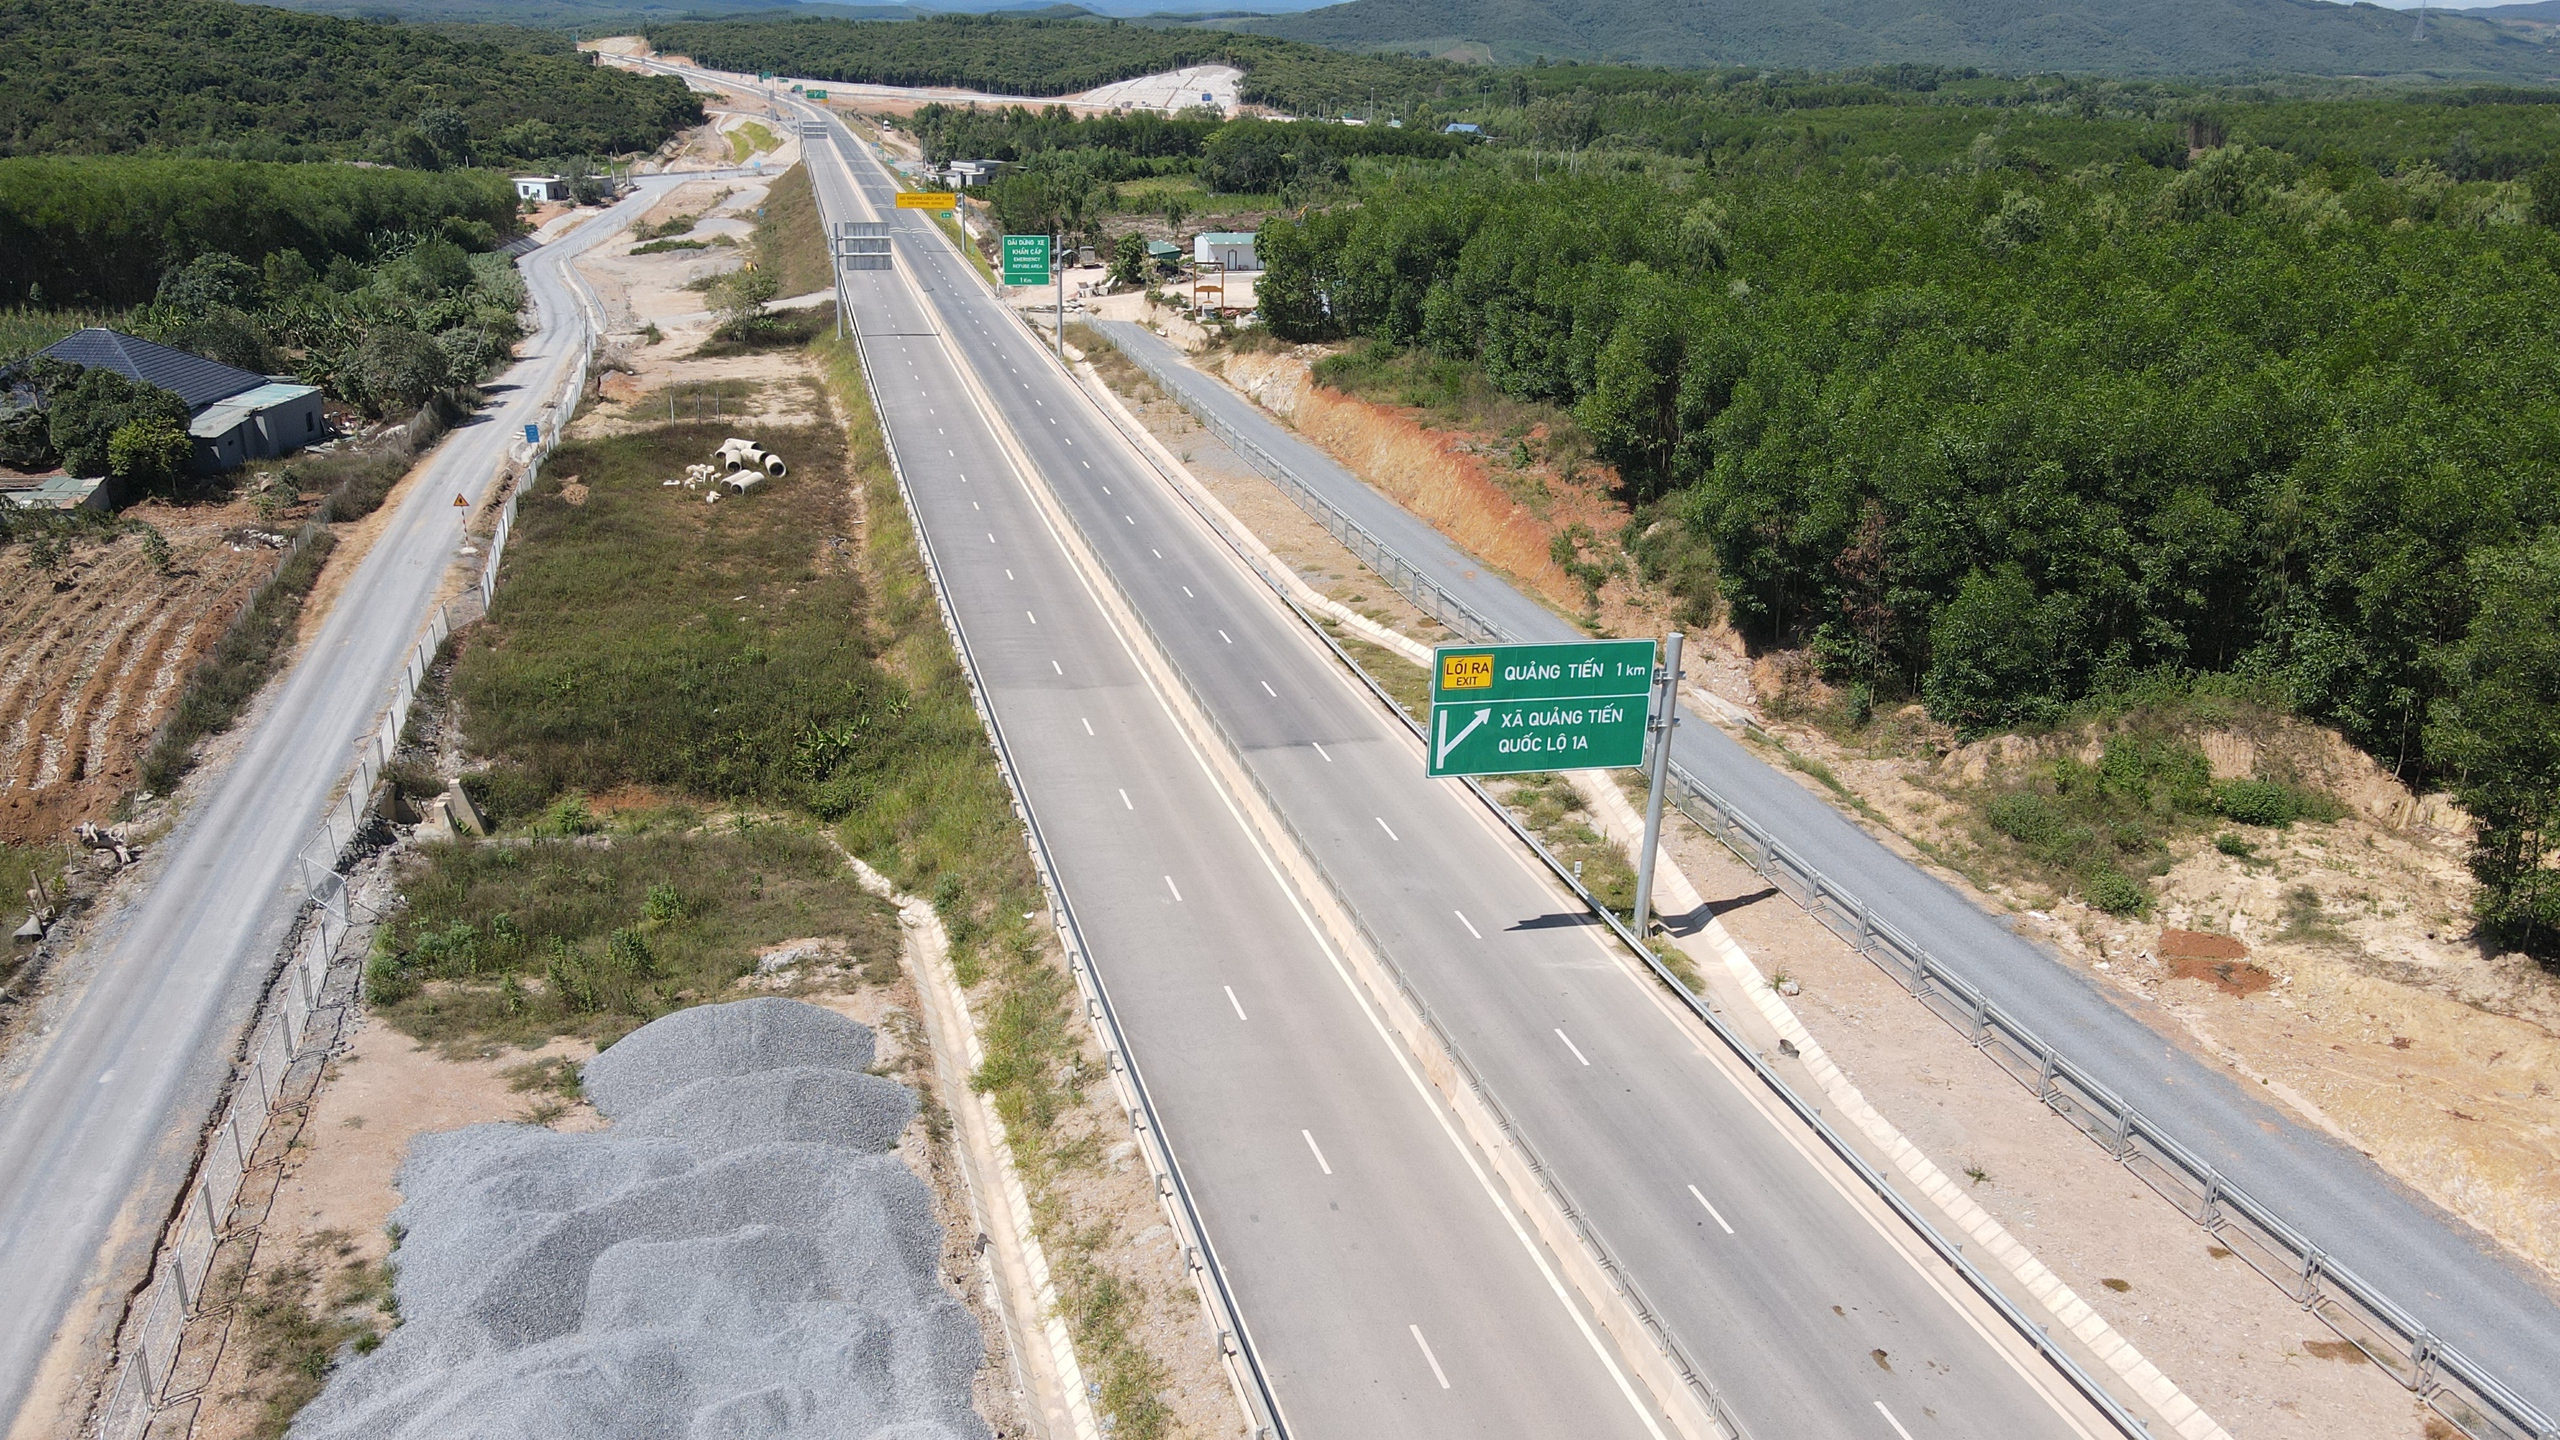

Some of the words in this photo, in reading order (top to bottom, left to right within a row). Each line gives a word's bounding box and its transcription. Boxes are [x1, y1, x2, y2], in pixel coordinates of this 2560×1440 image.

[1446, 658, 1467, 675] LỐI
[1471, 662, 1490, 674] RA
[1504, 660, 1561, 681] QUẢNG
[1568, 657, 1604, 679] TIẾN
[1616, 662, 1622, 677] 1
[1626, 664, 1646, 677] km
[1456, 676, 1478, 686] EXIT
[1501, 709, 1524, 729] XÃ
[1528, 707, 1583, 727] QUẢNG
[1588, 703, 1623, 724] TIẾN
[1498, 732, 1542, 754] QUỐC
[1546, 733, 1567, 754] LỘ
[1572, 735, 1589, 751] 1A
